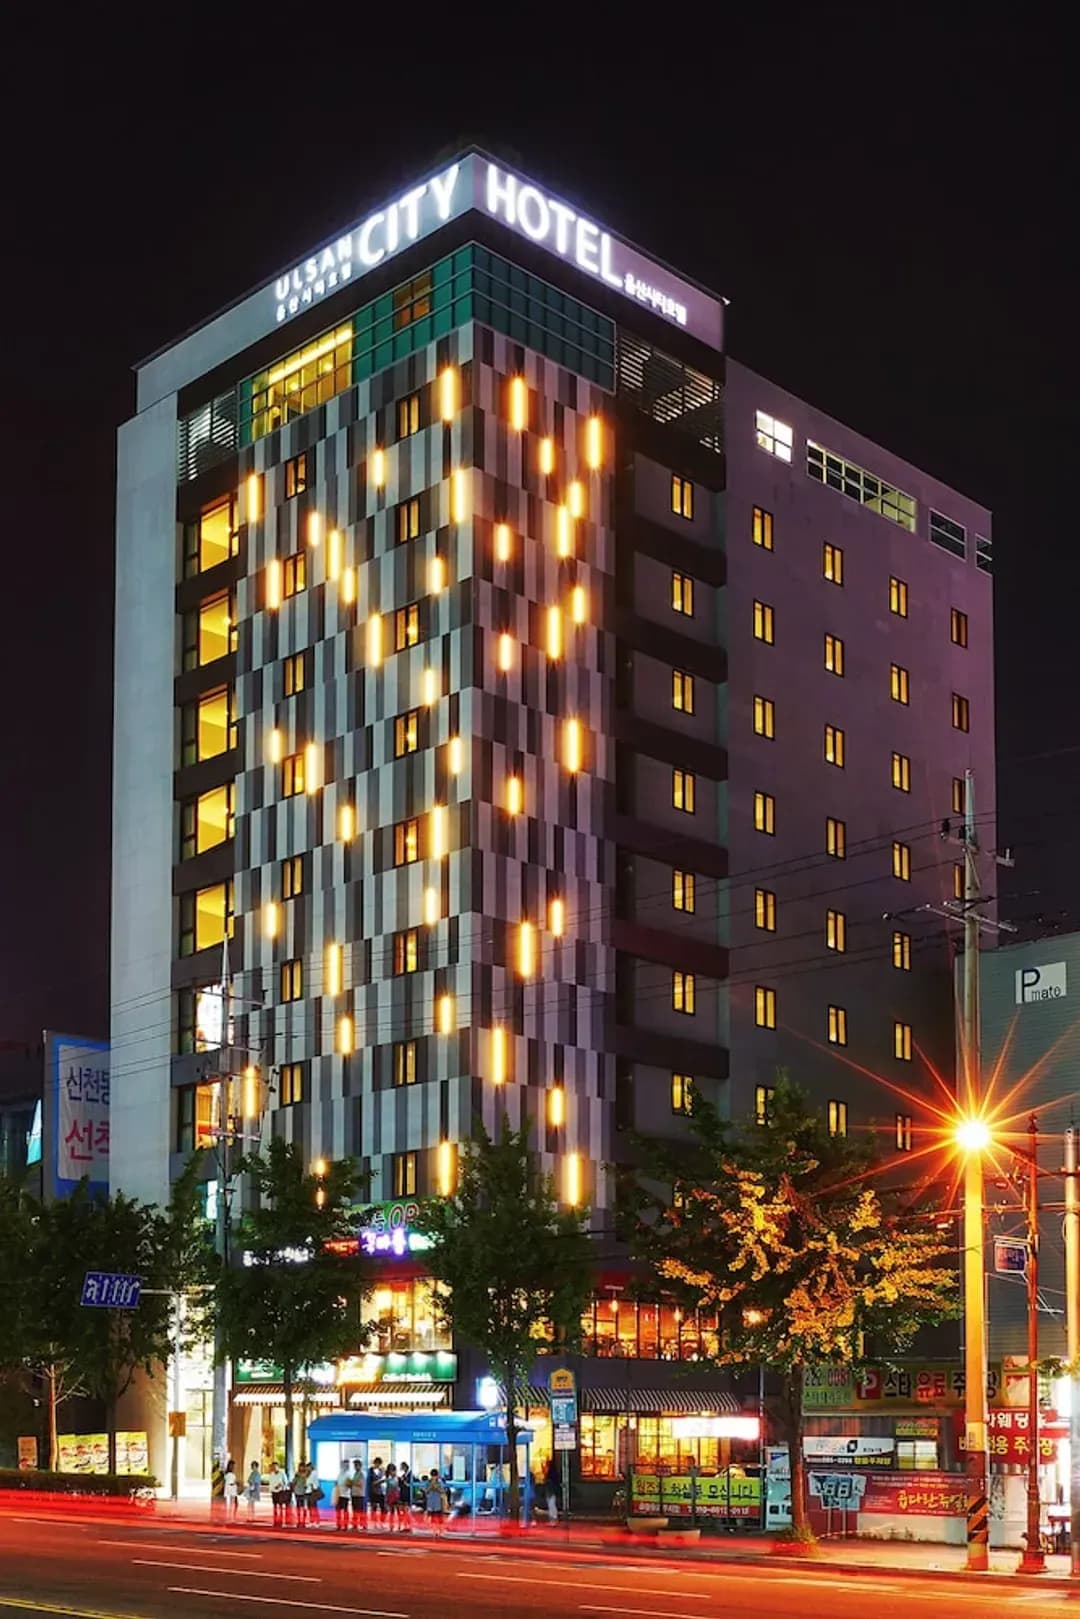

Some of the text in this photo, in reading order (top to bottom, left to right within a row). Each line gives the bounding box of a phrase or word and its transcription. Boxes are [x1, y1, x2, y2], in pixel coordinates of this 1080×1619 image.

[275, 163, 460, 300] ULSAN CITY
[485, 164, 624, 288] HOTEL
[917, 1372, 946, 1398] 유료
[953, 1370, 997, 1399] 주장
[1014, 1436, 1054, 1457] 주장
